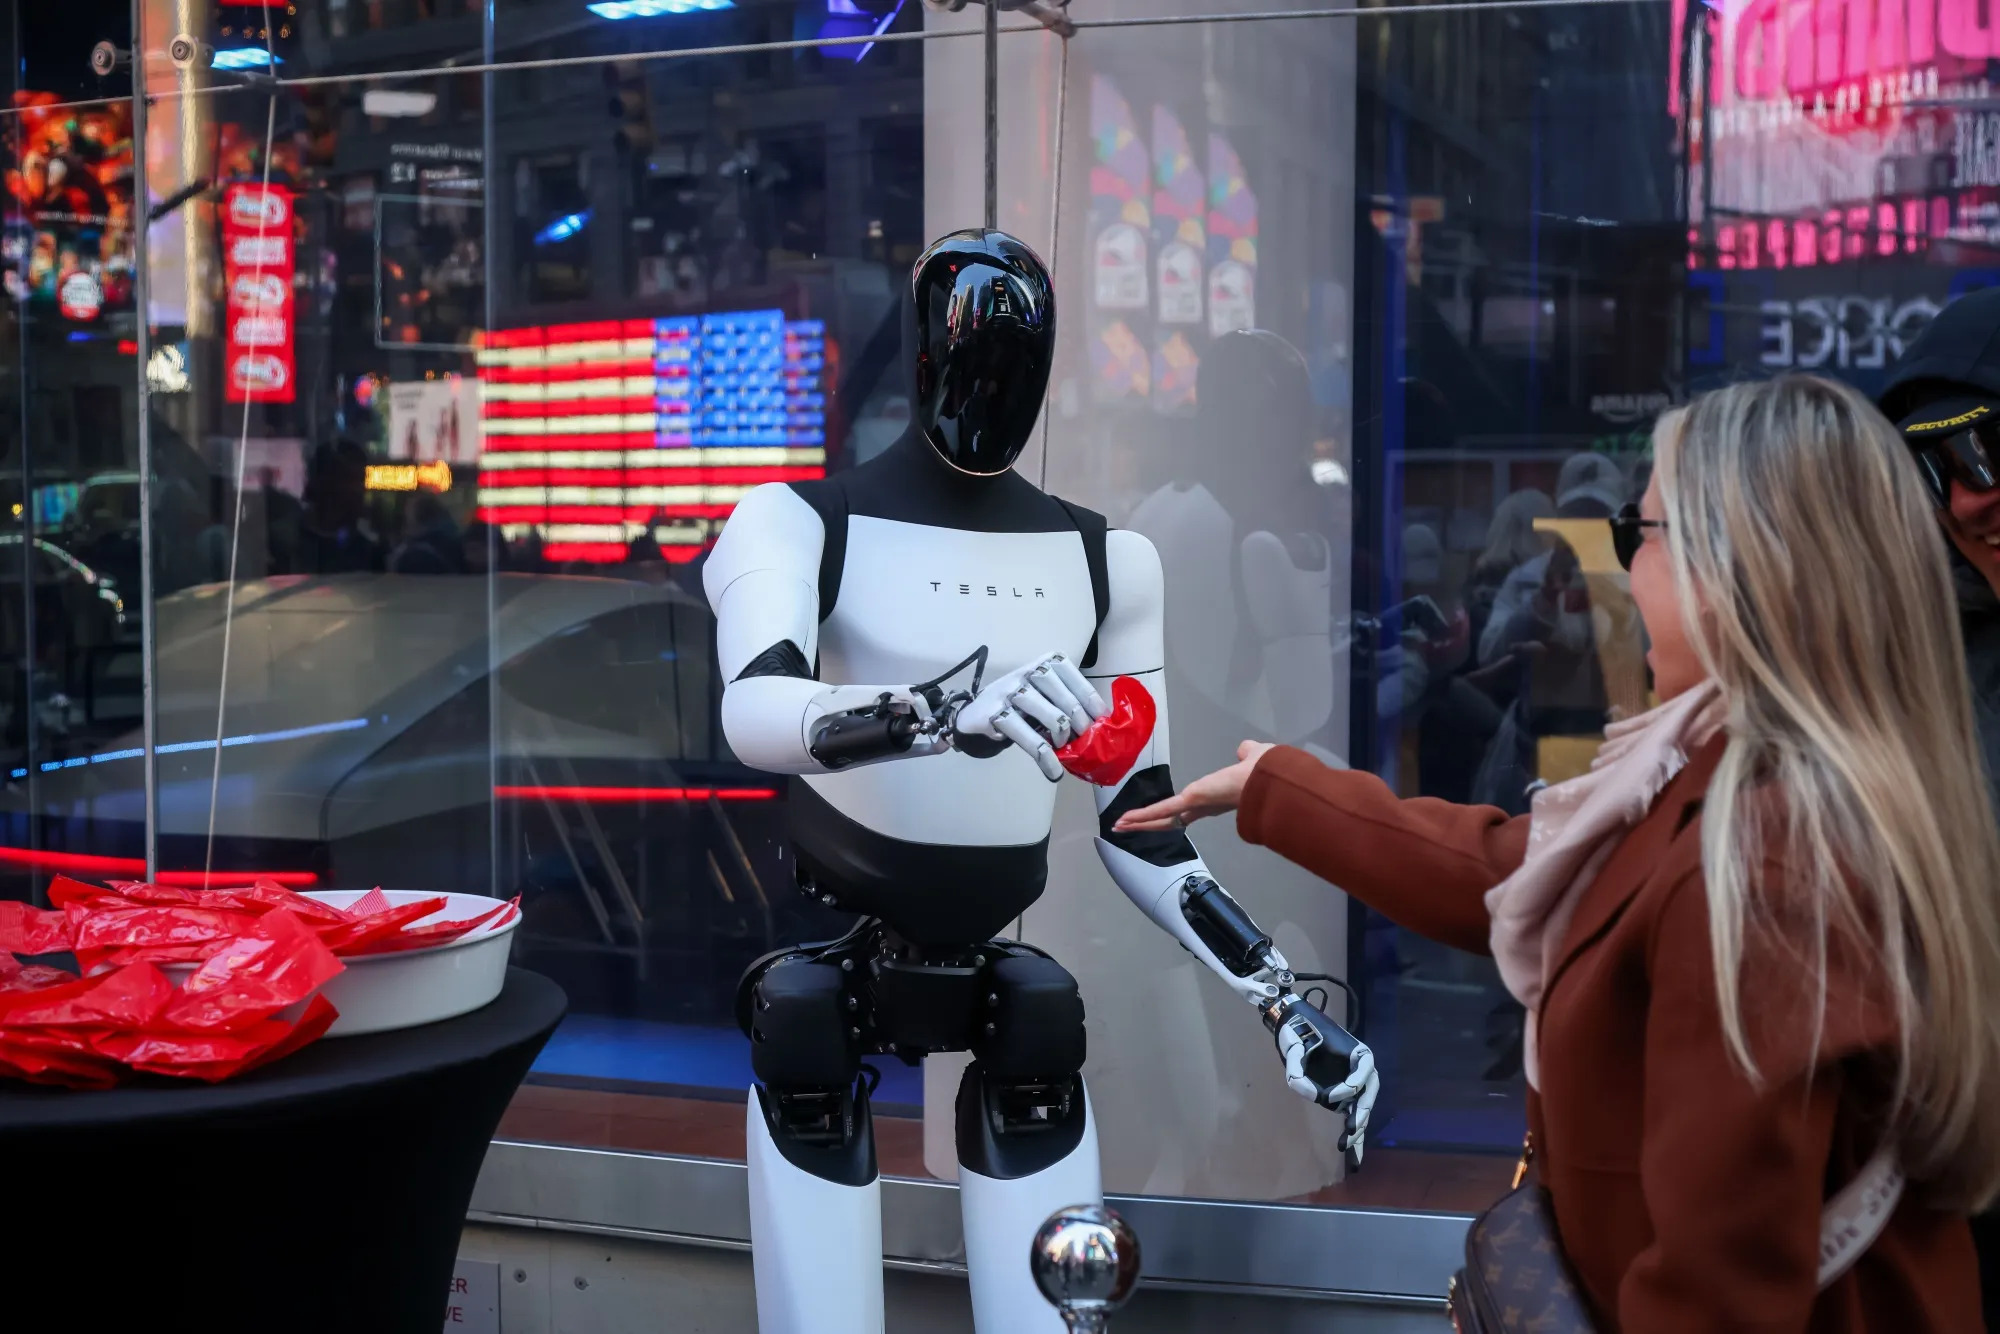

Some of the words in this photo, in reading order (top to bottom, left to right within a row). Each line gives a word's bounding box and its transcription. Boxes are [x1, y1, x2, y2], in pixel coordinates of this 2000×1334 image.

[1905, 406, 1990, 432] SECURITY
[929, 581, 1045, 598] TESLA
[448, 1276, 468, 1295] ER
